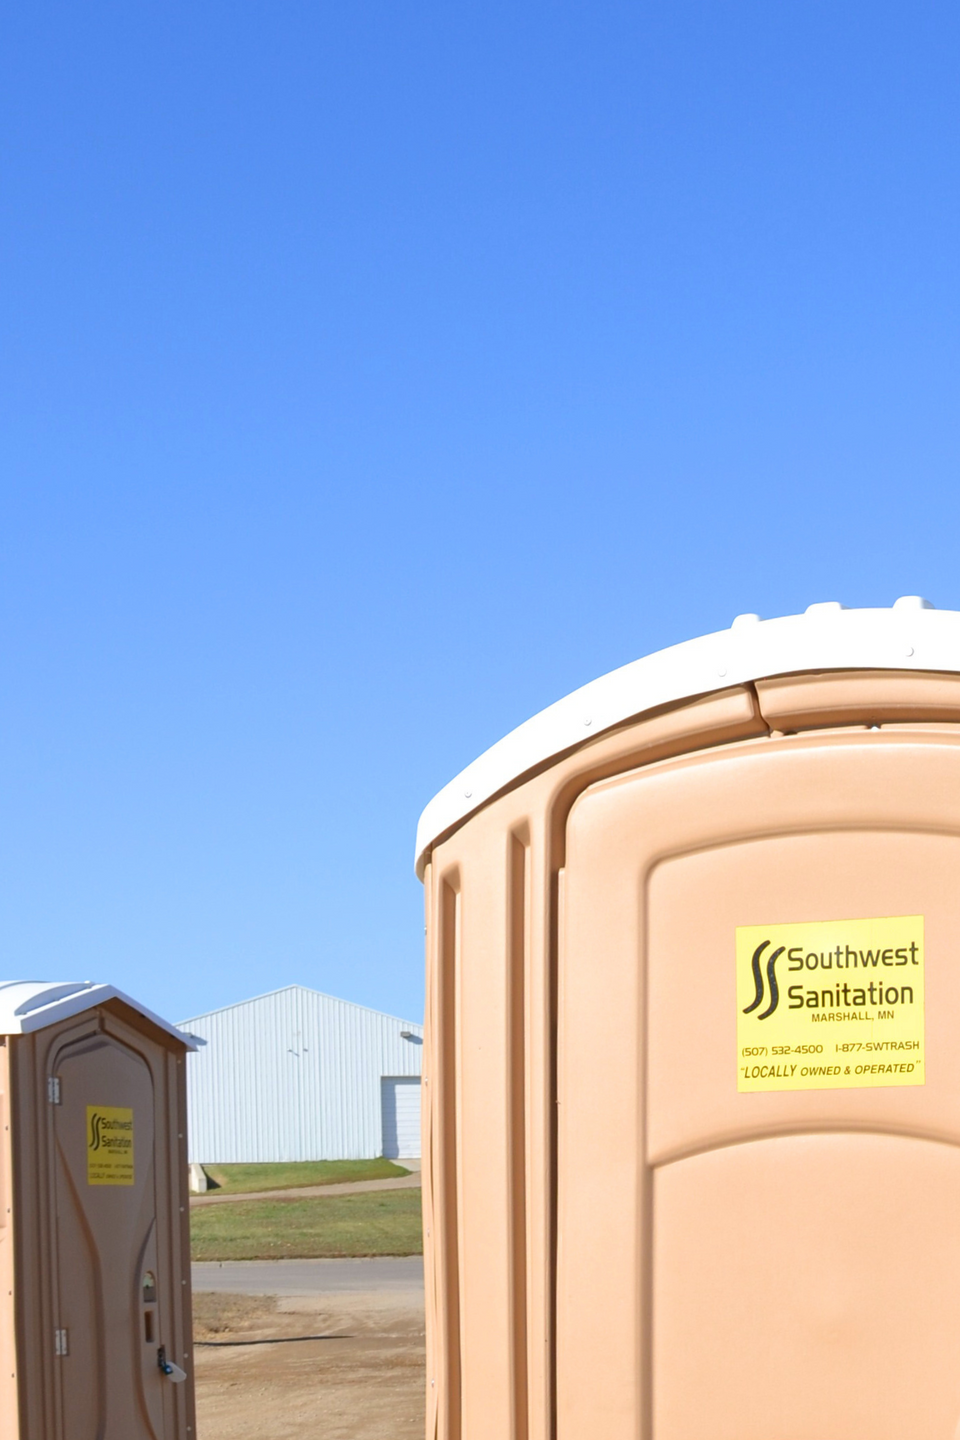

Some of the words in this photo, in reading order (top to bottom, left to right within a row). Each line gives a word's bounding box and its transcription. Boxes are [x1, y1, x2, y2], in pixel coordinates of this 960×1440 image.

[787, 941, 919, 971] Southwest
[787, 981, 914, 1009] Sanitation
[811, 1011, 874, 1022] MARSHALL,
[877, 1010, 895, 1020] MN
[741, 1047, 768, 1057] (507)
[771, 1044, 824, 1055] 532-4500
[800, 1066, 841, 1077] OWNED
[844, 1065, 852, 1075] &
